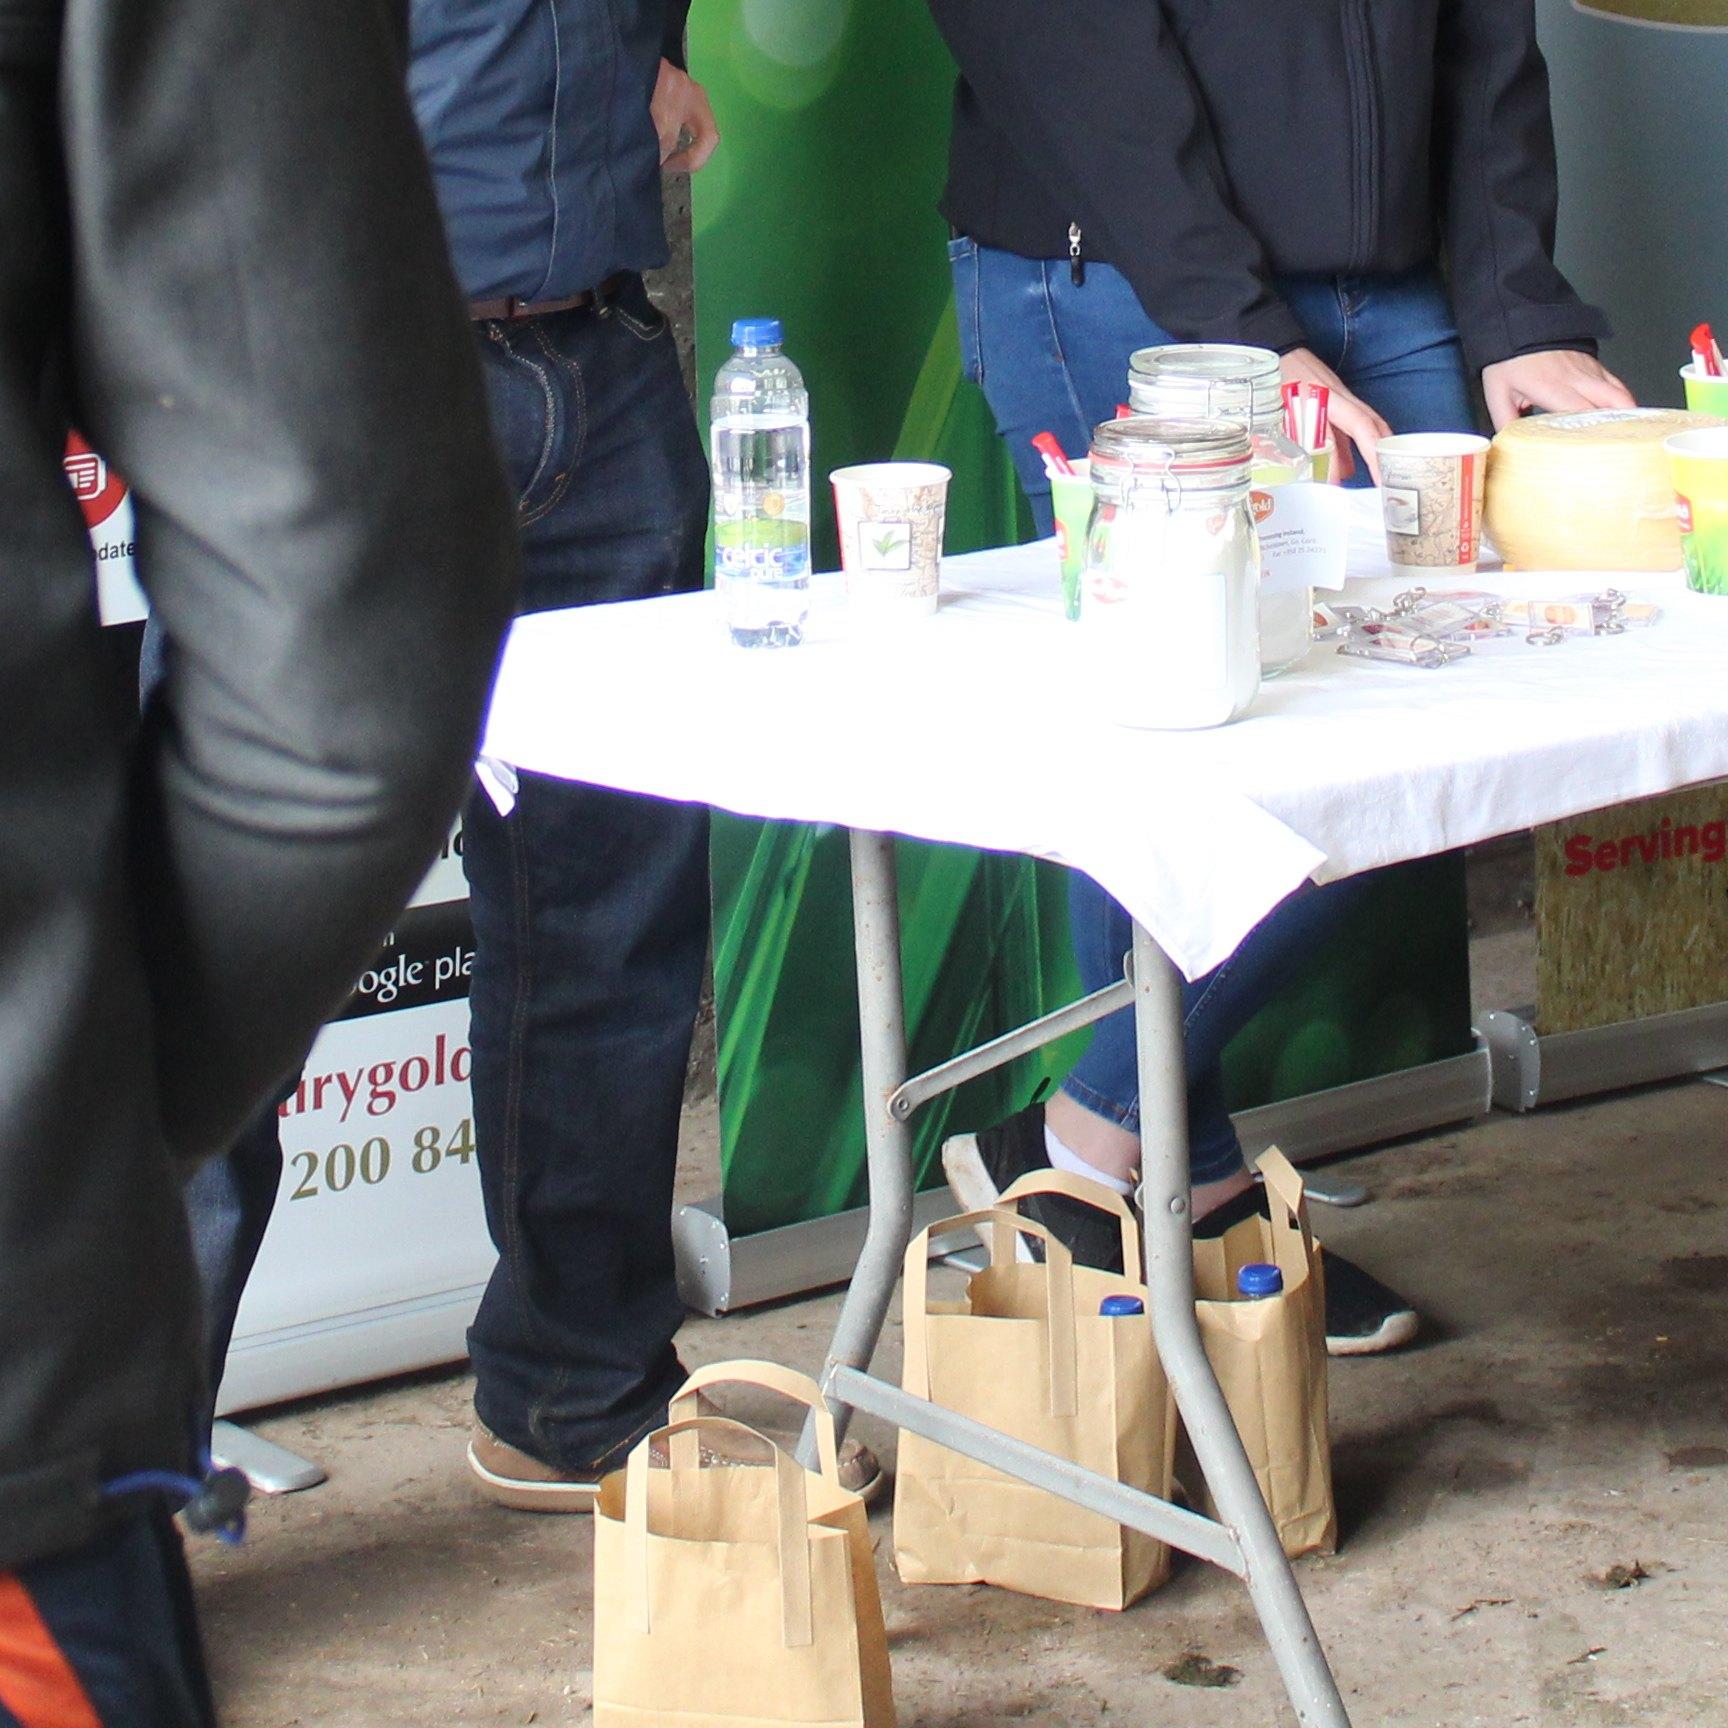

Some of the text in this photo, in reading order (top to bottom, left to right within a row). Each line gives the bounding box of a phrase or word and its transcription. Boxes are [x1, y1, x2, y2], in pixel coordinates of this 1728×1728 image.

[92, 539, 136, 561] date
[1562, 813, 1728, 880] Serving
[349, 953, 423, 1003] ogle
